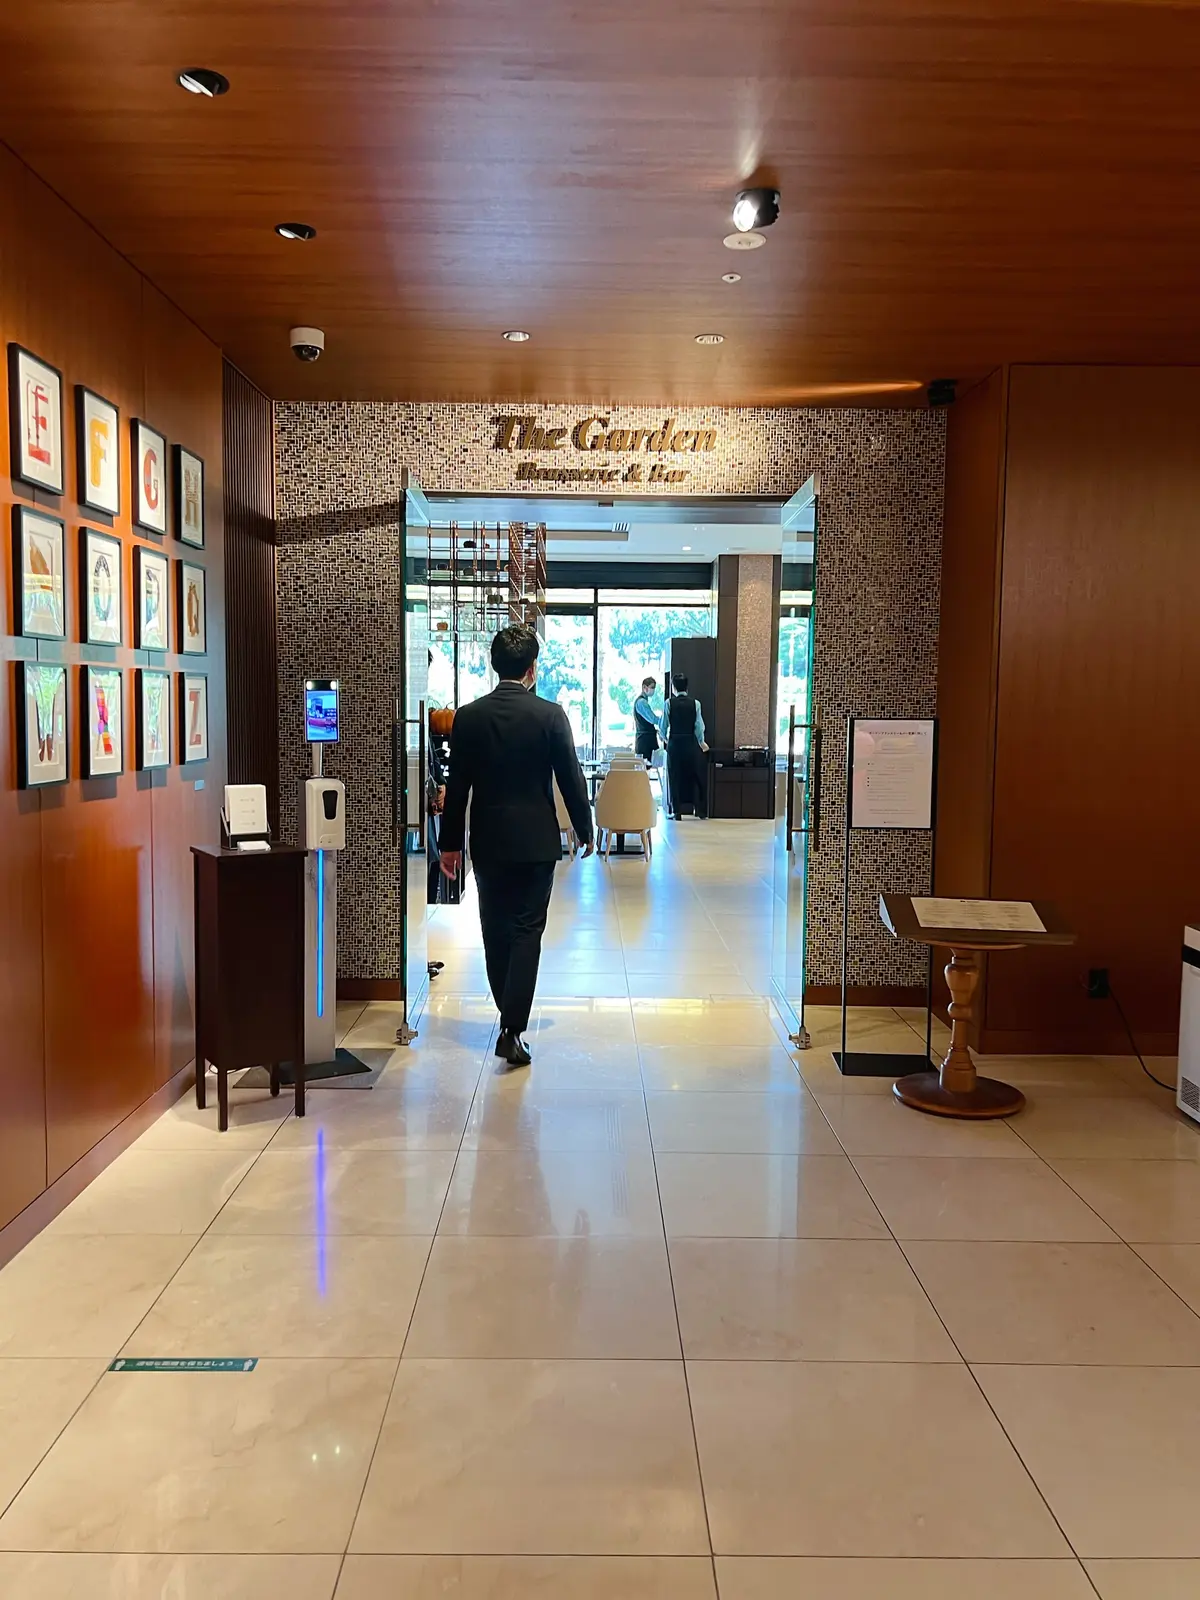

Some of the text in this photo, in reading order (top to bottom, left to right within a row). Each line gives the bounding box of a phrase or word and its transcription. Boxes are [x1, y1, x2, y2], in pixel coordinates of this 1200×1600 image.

[491, 415, 718, 452] The Garden
[515, 462, 692, 483] Brasserie & Bar
